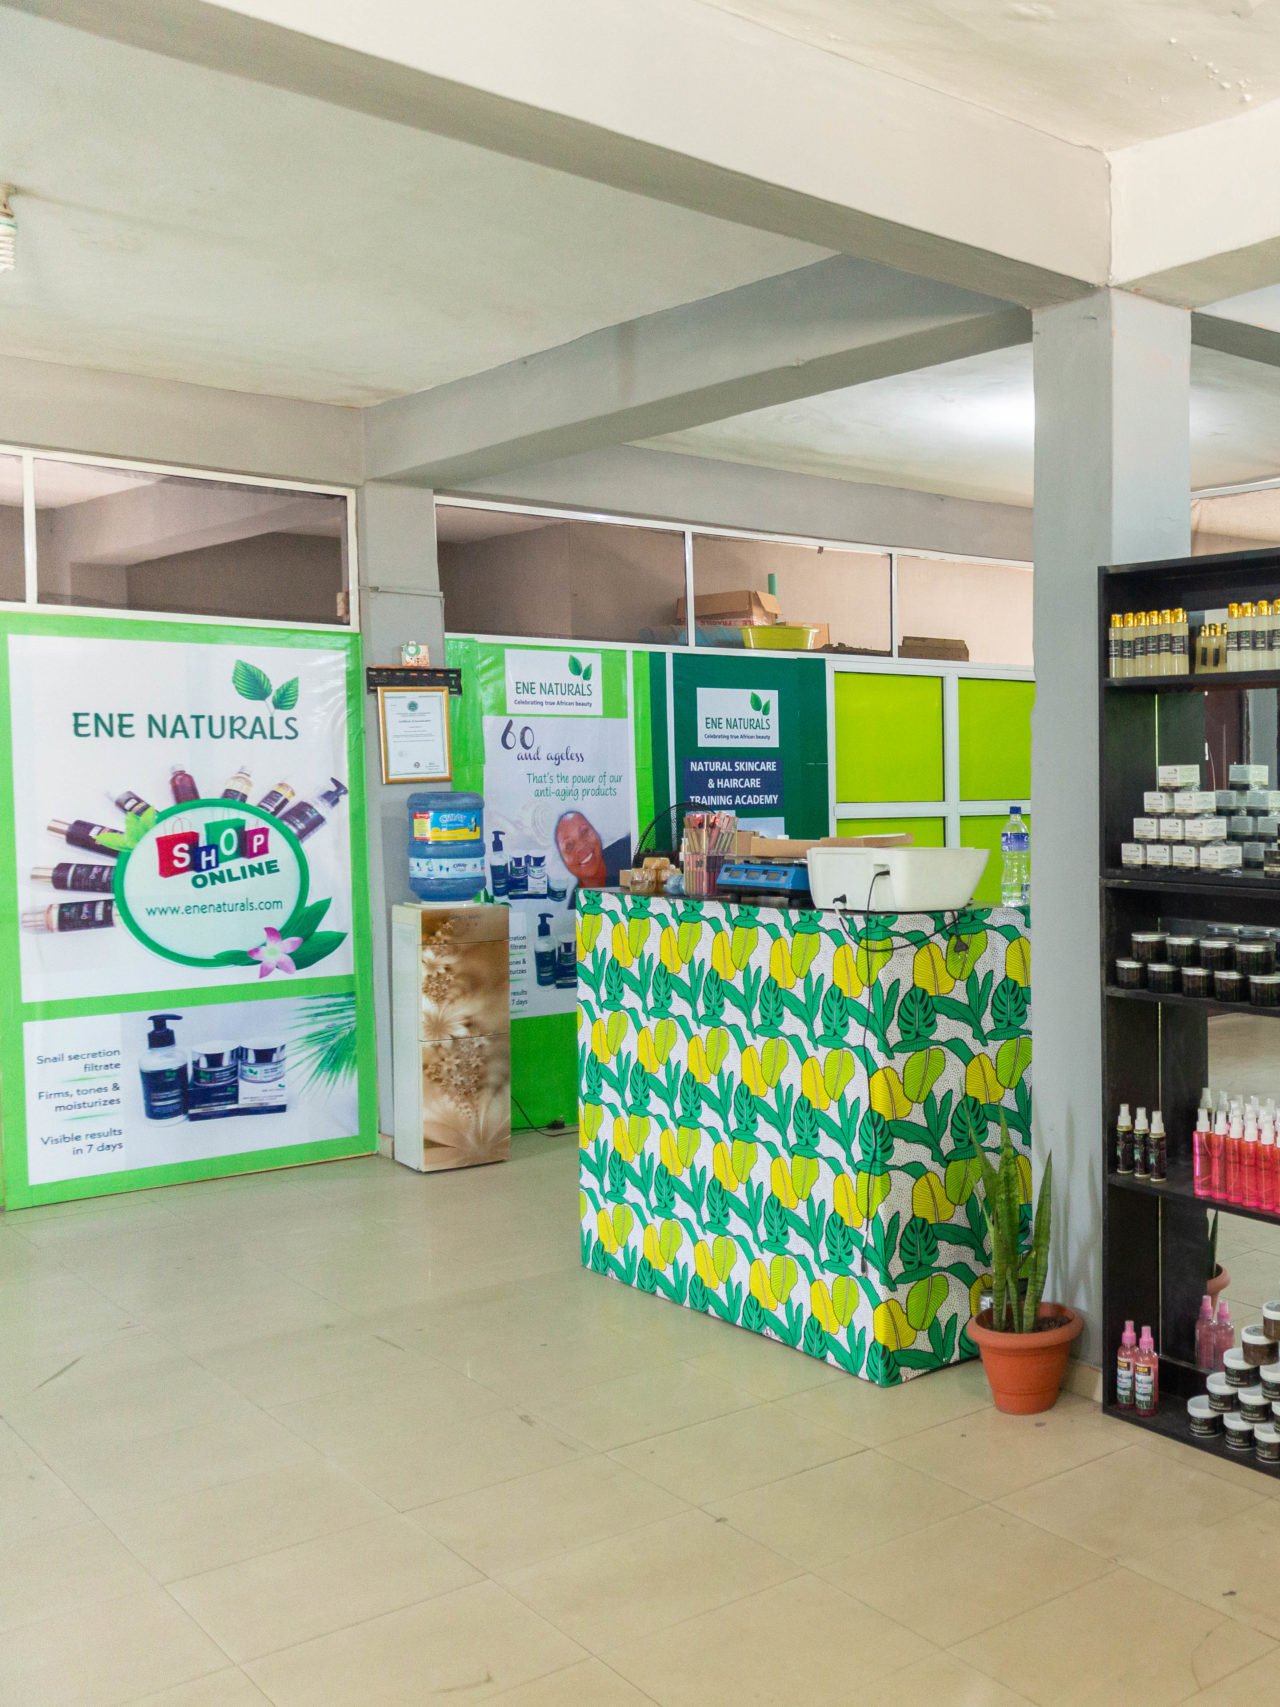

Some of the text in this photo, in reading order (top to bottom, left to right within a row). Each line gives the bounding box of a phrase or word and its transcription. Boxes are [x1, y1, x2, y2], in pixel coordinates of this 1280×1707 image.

[515, 681, 592, 696] ENE NATURALS
[514, 699, 544, 707] Celebrating
[72, 712, 299, 740] ENE NATURALS
[705, 717, 771, 730] ENE NATURALS
[501, 719, 535, 750] 60
[517, 746, 585, 766] and ageless
[690, 761, 777, 772] NATURAL SKINCARE
[526, 771, 623, 788] That's the power of our
[707, 778, 761, 789] & HAIRCARE
[534, 787, 617, 801] anti-aging products
[689, 794, 778, 806] TRAINING ACADEMY
[172, 828, 265, 869] SHOP
[191, 859, 280, 889] ONLINE
[145, 897, 283, 917] www.enenaturals.com
[36, 1049, 121, 1065] Snail secretion
[83, 1061, 121, 1073] filtrate
[38, 1082, 120, 1100] Firms, tones &
[54, 1097, 121, 1112] moisturizes
[40, 1128, 123, 1145] Visible results
[72, 1142, 123, 1156] in 7 days
